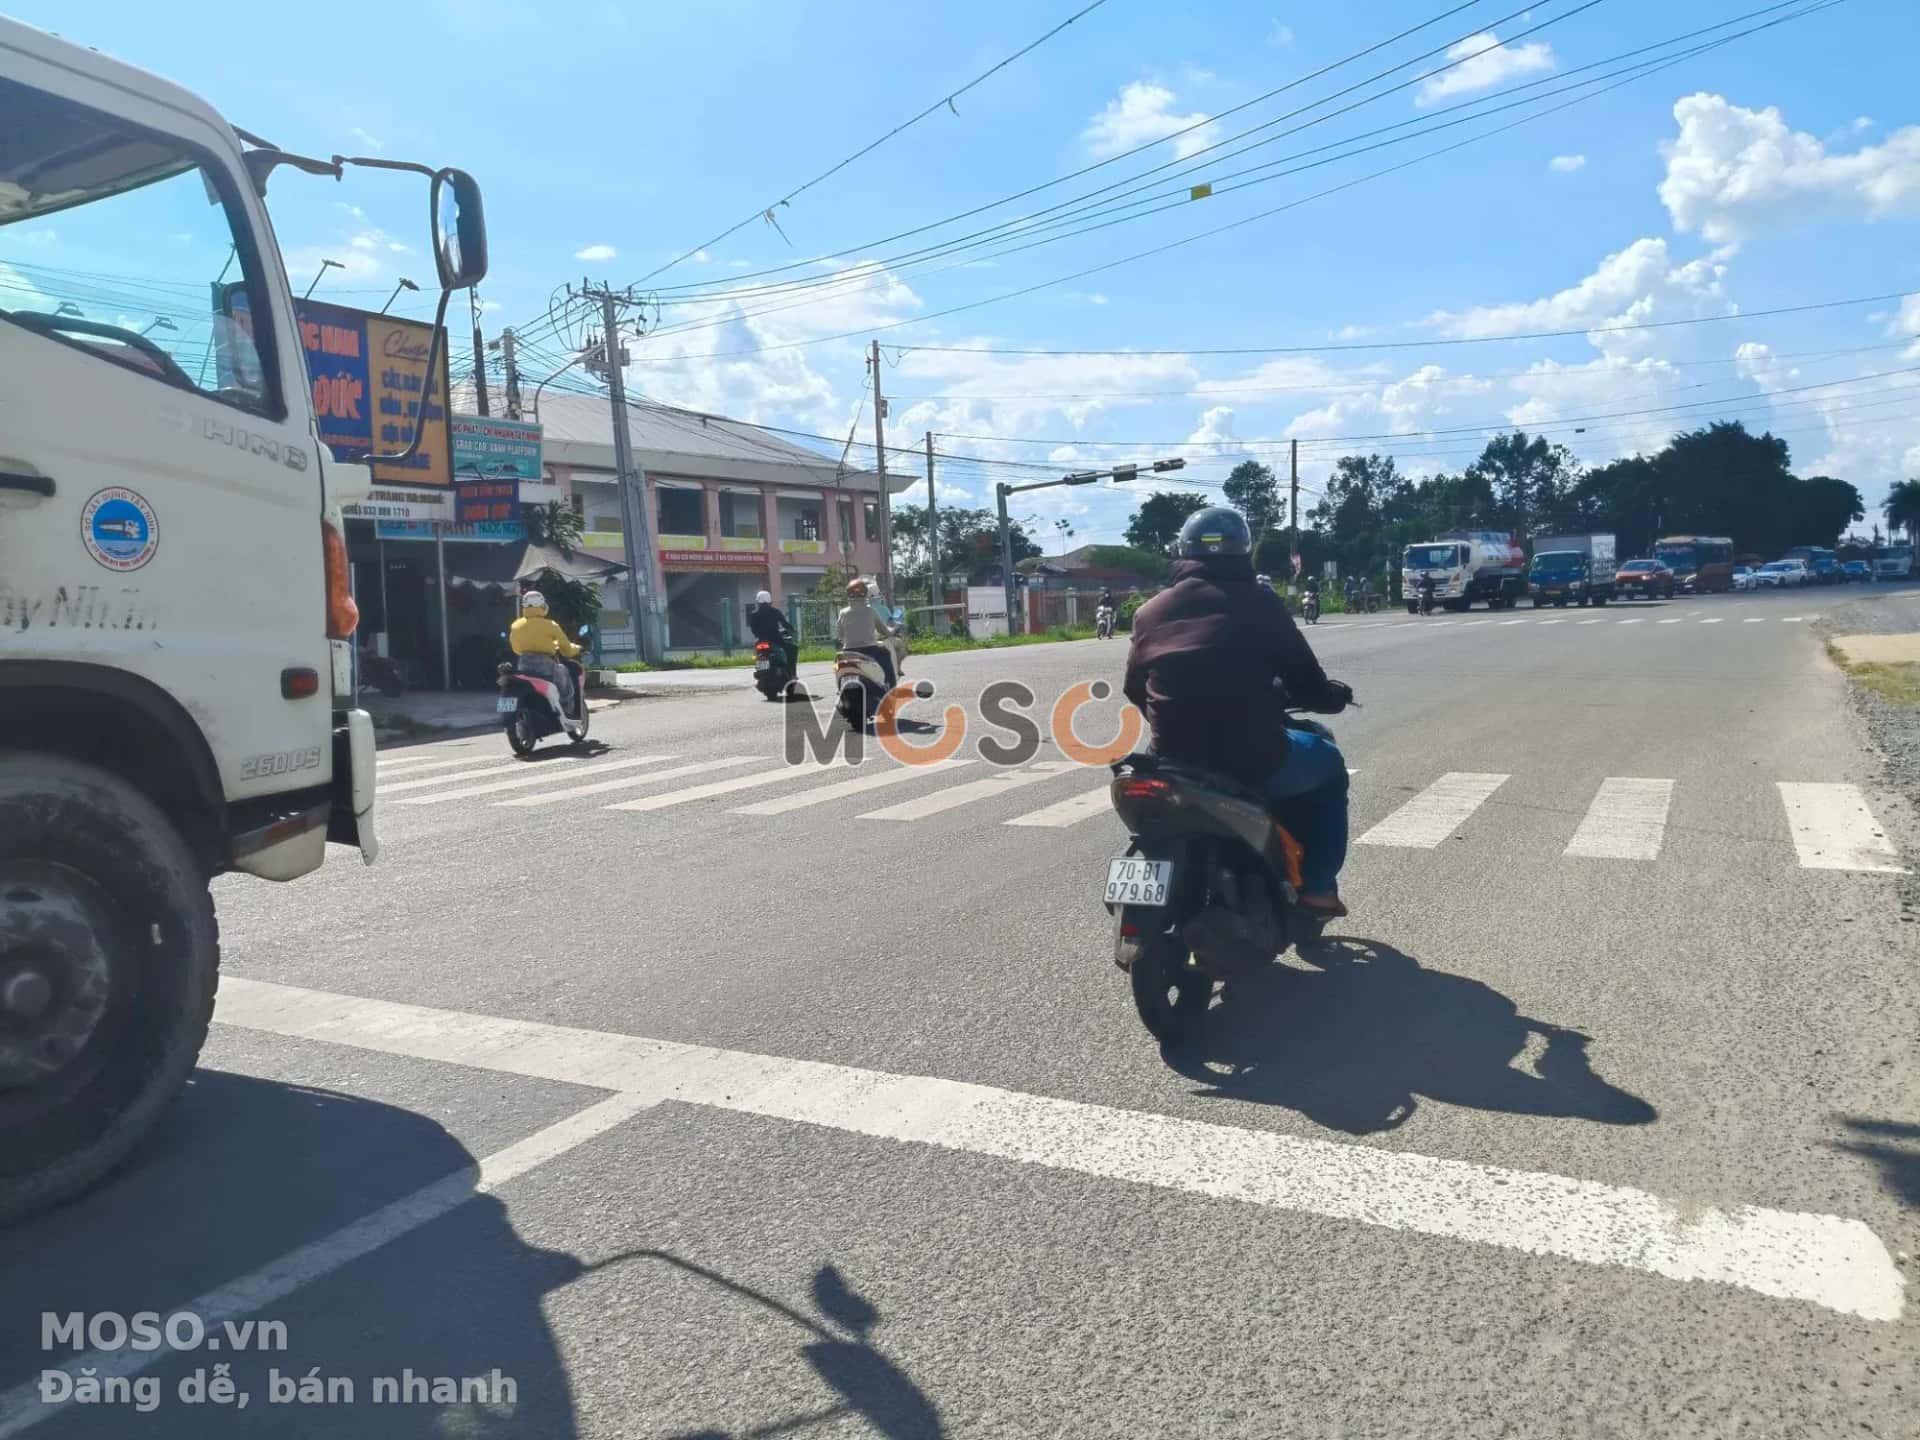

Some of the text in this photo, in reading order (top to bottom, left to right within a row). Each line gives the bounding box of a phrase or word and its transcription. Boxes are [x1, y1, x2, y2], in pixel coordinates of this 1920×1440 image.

[203, 416, 308, 473] HINO
[240, 746, 321, 782] 260PS
[1107, 882, 1164, 904] 979.68
